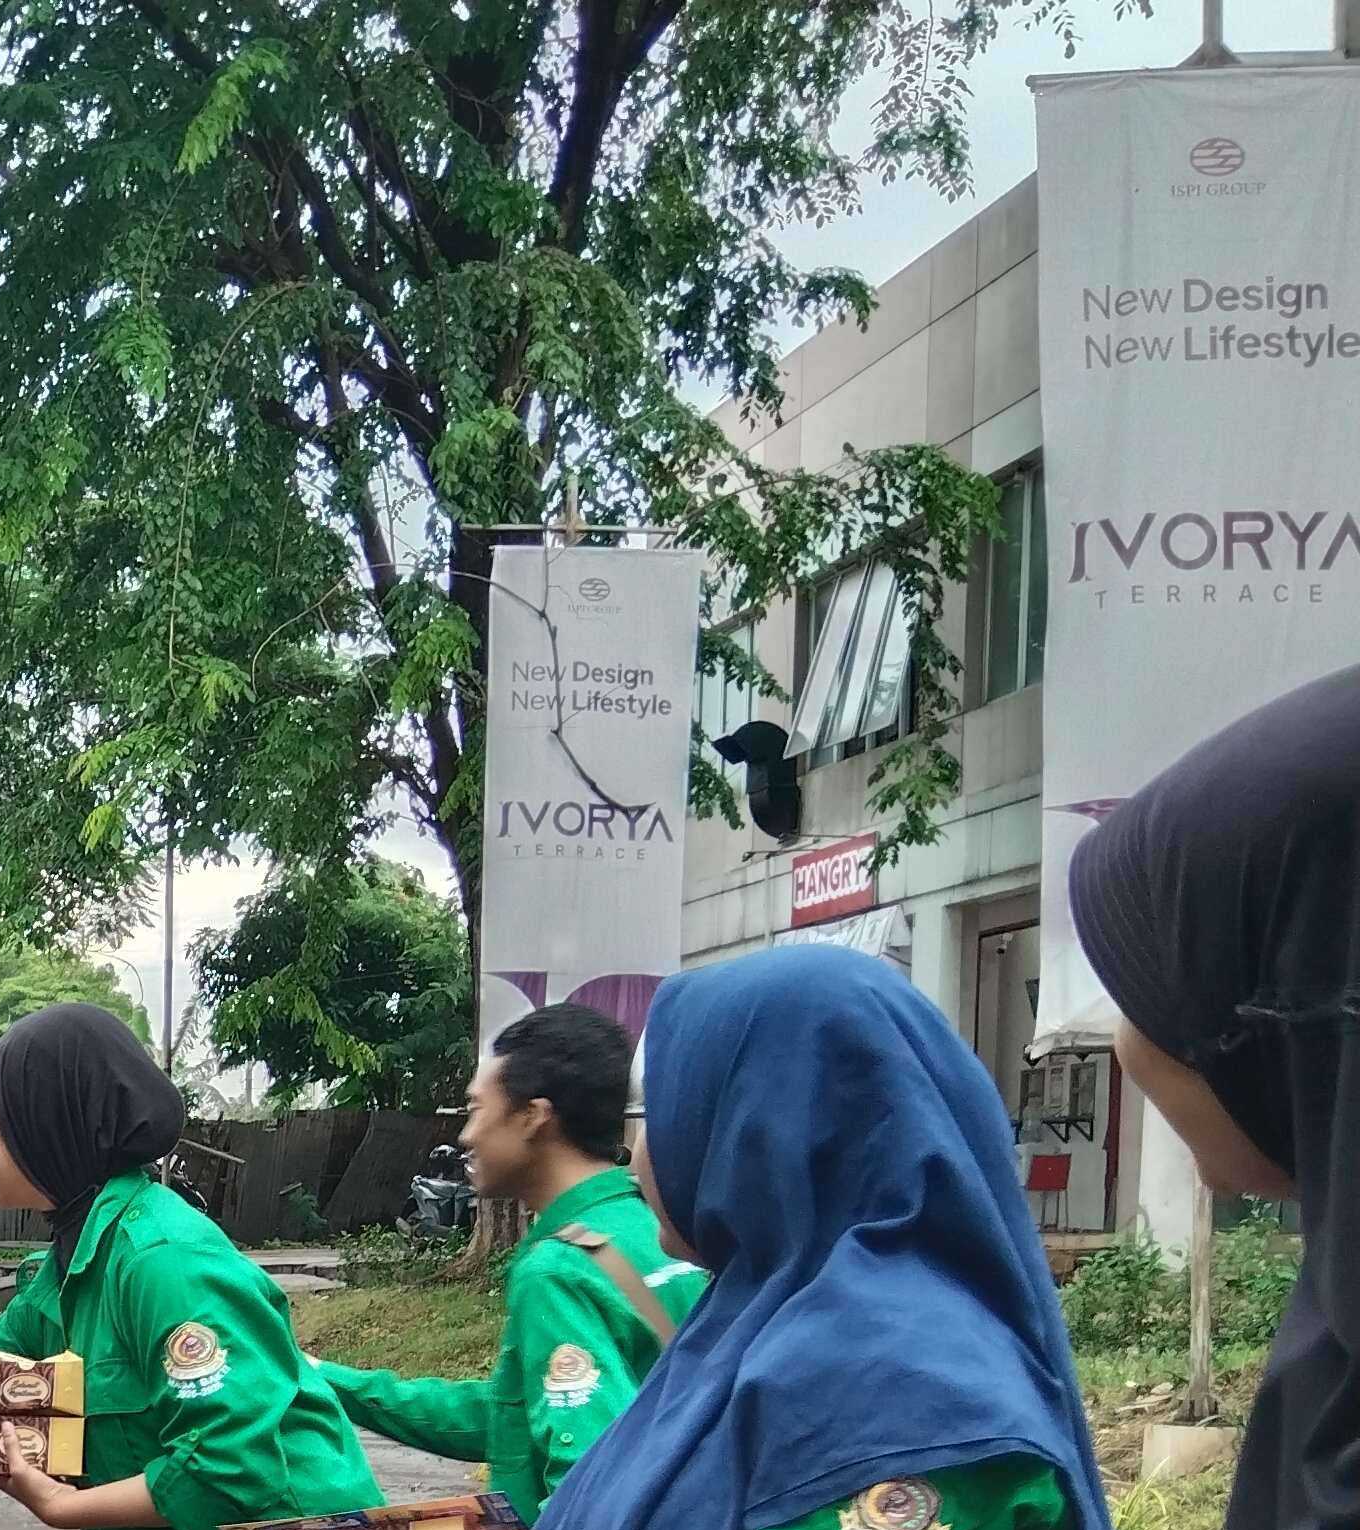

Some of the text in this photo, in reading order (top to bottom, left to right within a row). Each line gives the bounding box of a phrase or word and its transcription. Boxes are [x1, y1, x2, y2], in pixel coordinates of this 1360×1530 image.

[1206, 182, 1267, 196] GROUP
[1082, 276, 1329, 323] New Design
[1084, 322, 1360, 370] New Lifestyle
[1093, 583, 1324, 610] TERRACE
[511, 661, 654, 690] New Design
[511, 690, 673, 720] New Lifestyle
[513, 843, 648, 861] TERRACE
